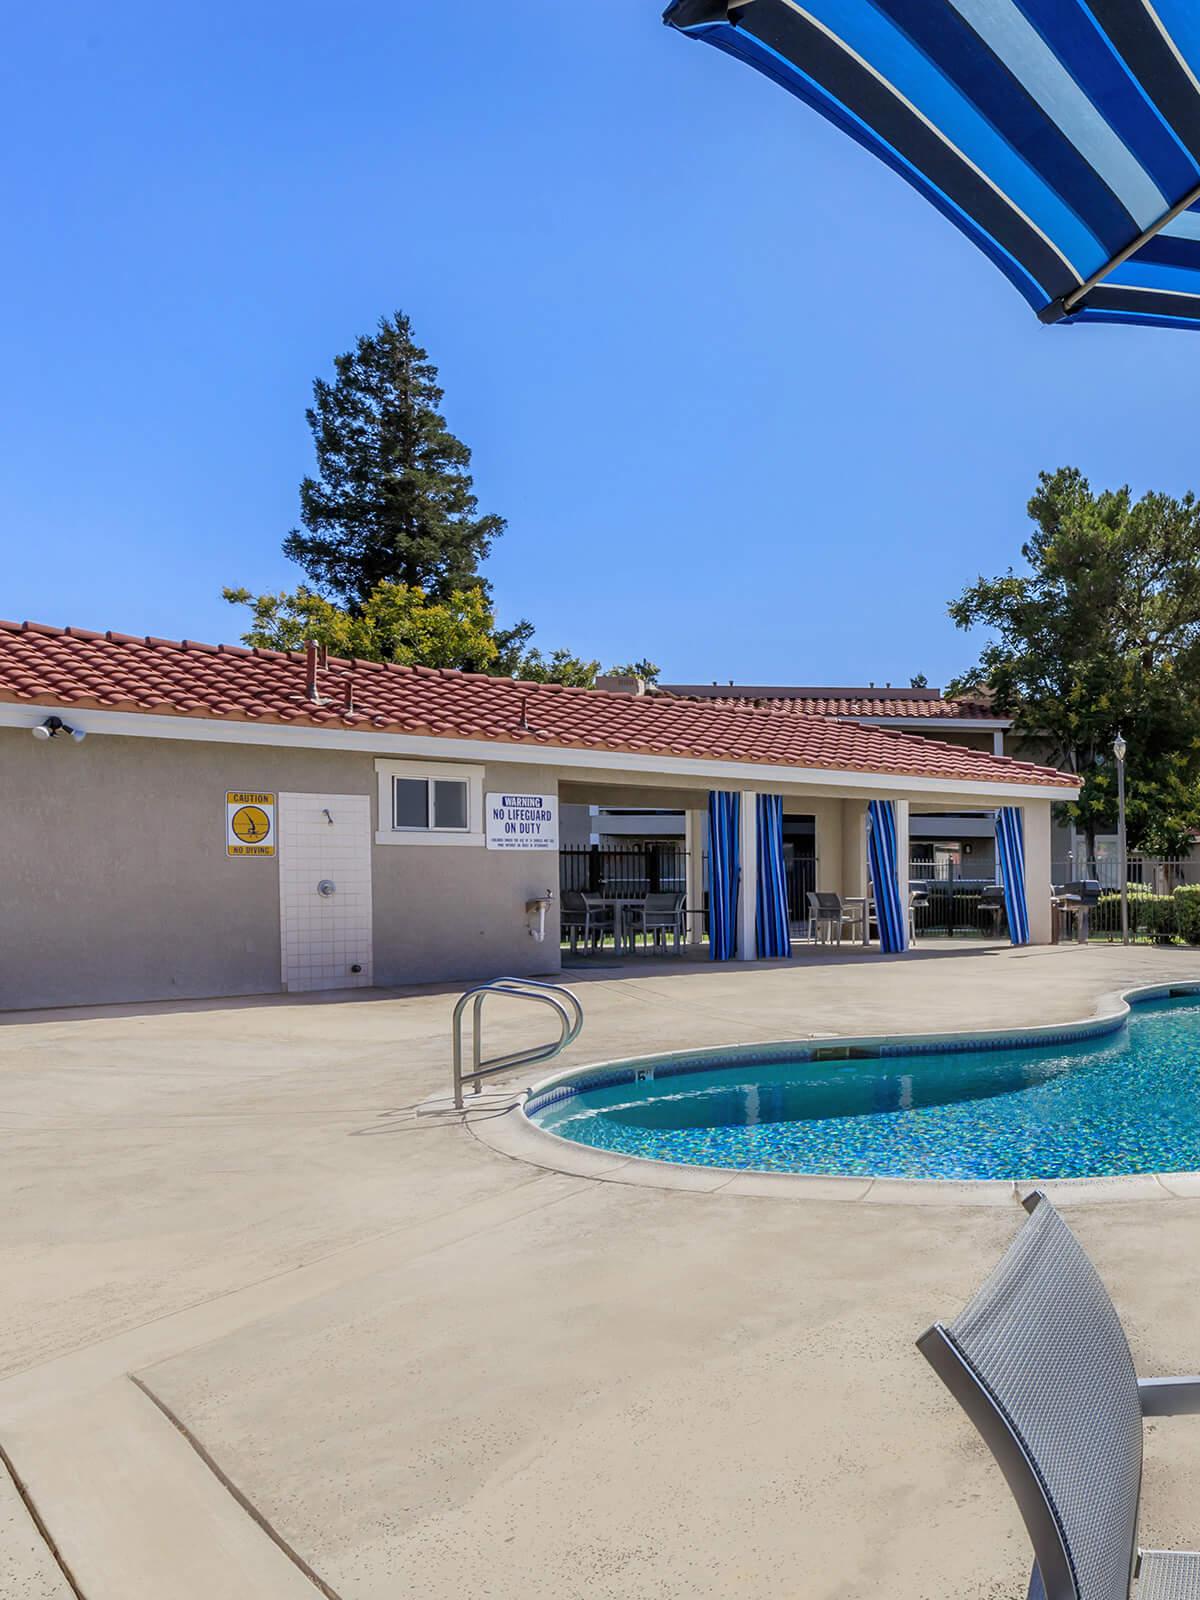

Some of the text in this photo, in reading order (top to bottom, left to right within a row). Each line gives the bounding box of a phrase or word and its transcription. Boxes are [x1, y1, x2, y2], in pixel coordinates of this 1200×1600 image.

[233, 793, 269, 803] CAUTION
[504, 796, 541, 808] WARNING
[493, 808, 552, 821] NO LIFEGUARD
[504, 822, 541, 834] ON DUTY
[233, 847, 270, 855] NO DIVING
